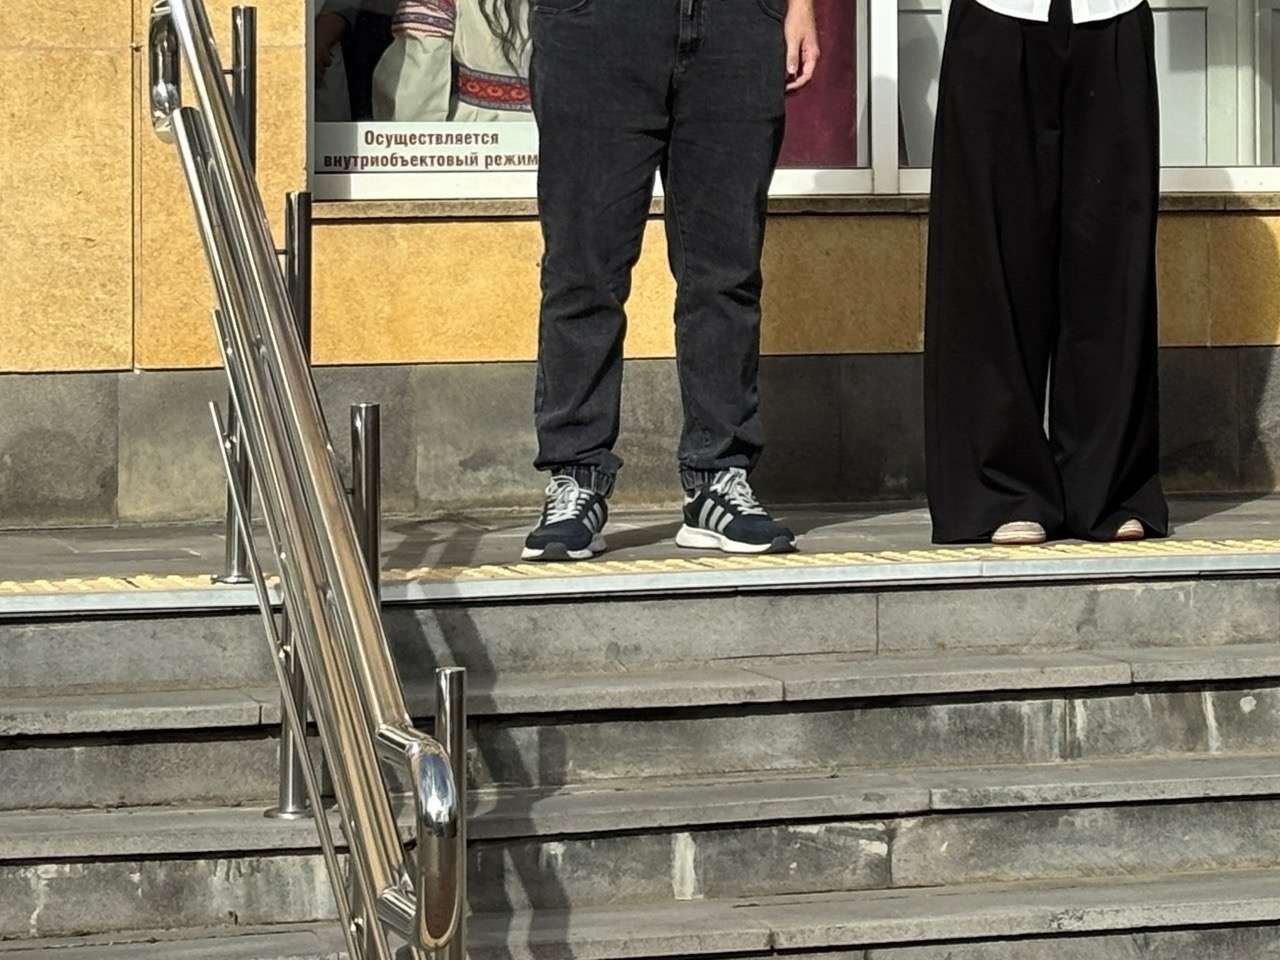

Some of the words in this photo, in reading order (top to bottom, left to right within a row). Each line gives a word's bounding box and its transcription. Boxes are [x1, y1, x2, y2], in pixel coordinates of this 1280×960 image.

[364, 130, 499, 148] Осуществляется
[323, 152, 479, 170] внутриобъектовый
[484, 154, 538, 170] режим
